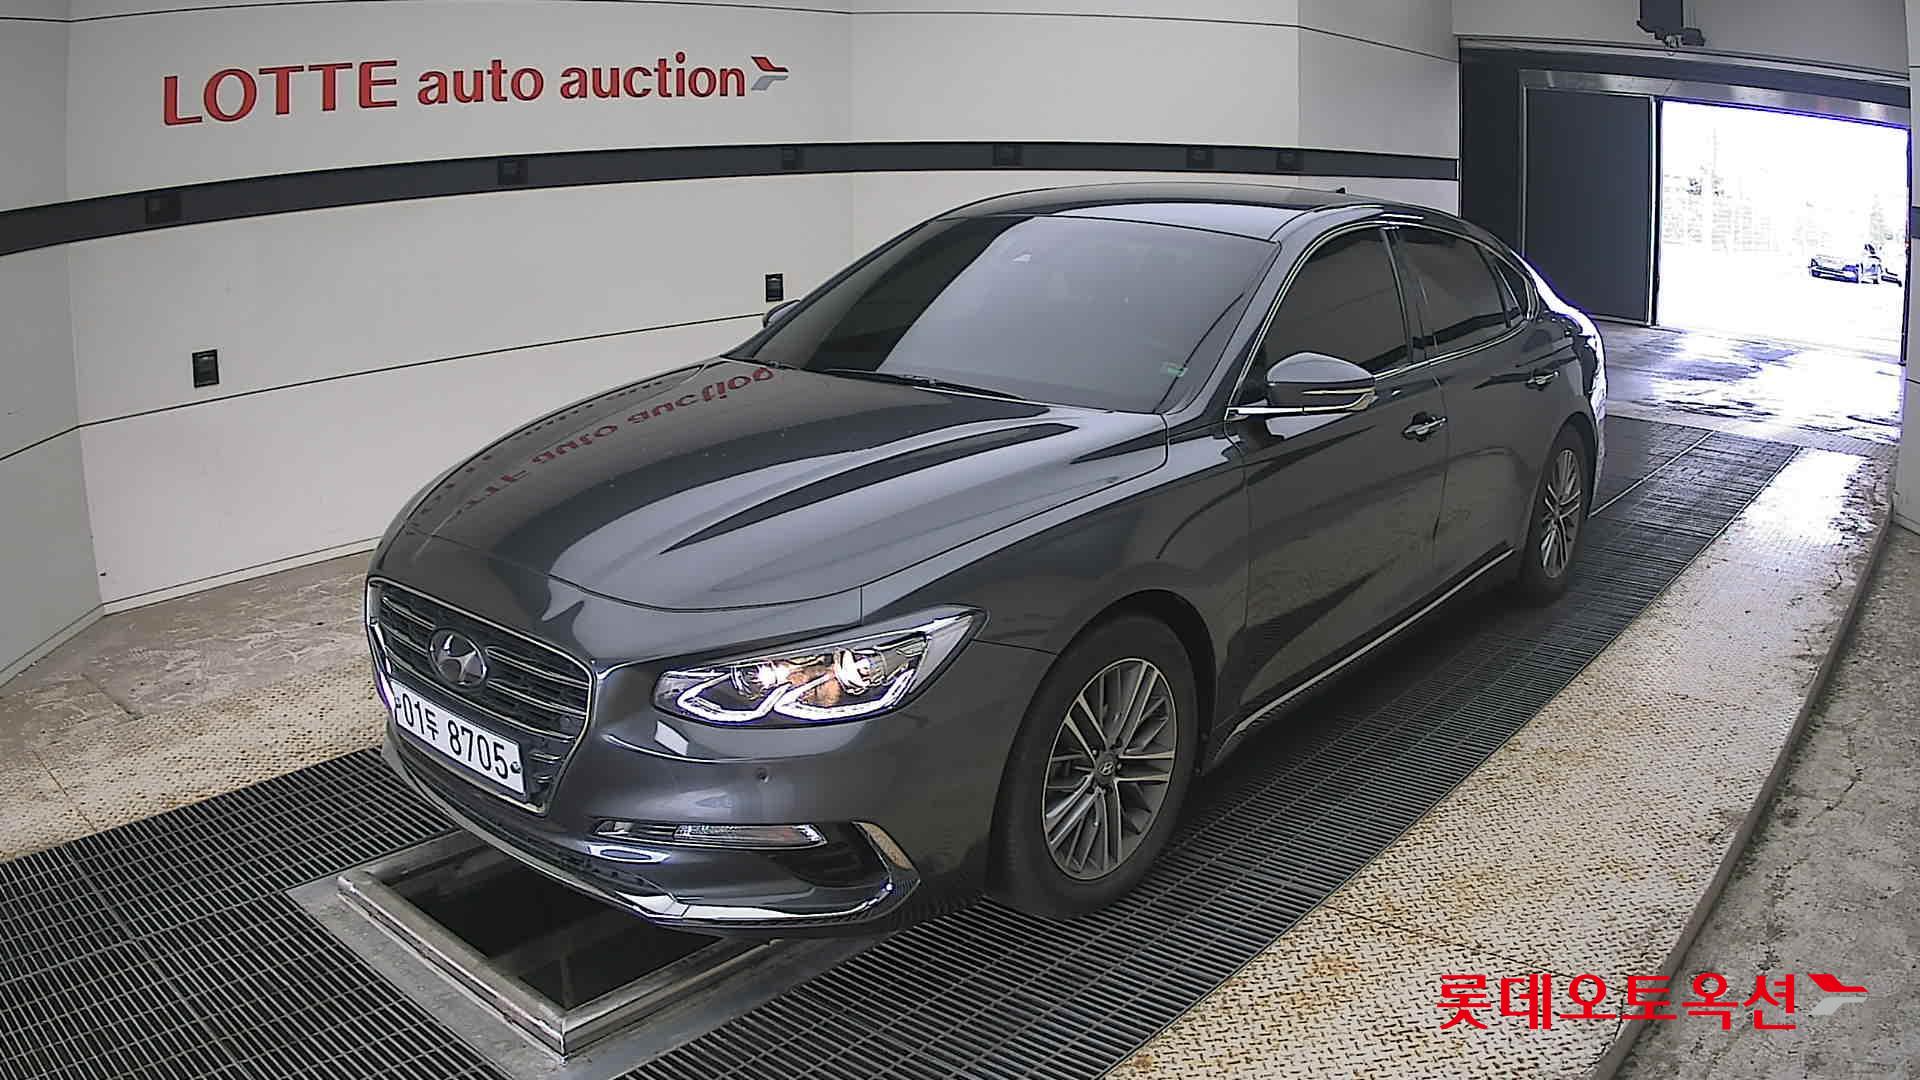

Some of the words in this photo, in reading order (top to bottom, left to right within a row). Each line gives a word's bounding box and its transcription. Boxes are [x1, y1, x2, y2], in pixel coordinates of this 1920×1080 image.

[163, 60, 398, 126] LOTTE
[417, 59, 545, 105] auto
[560, 51, 746, 100] auction
[402, 693, 439, 740] 01두
[448, 719, 509, 779] 8705
